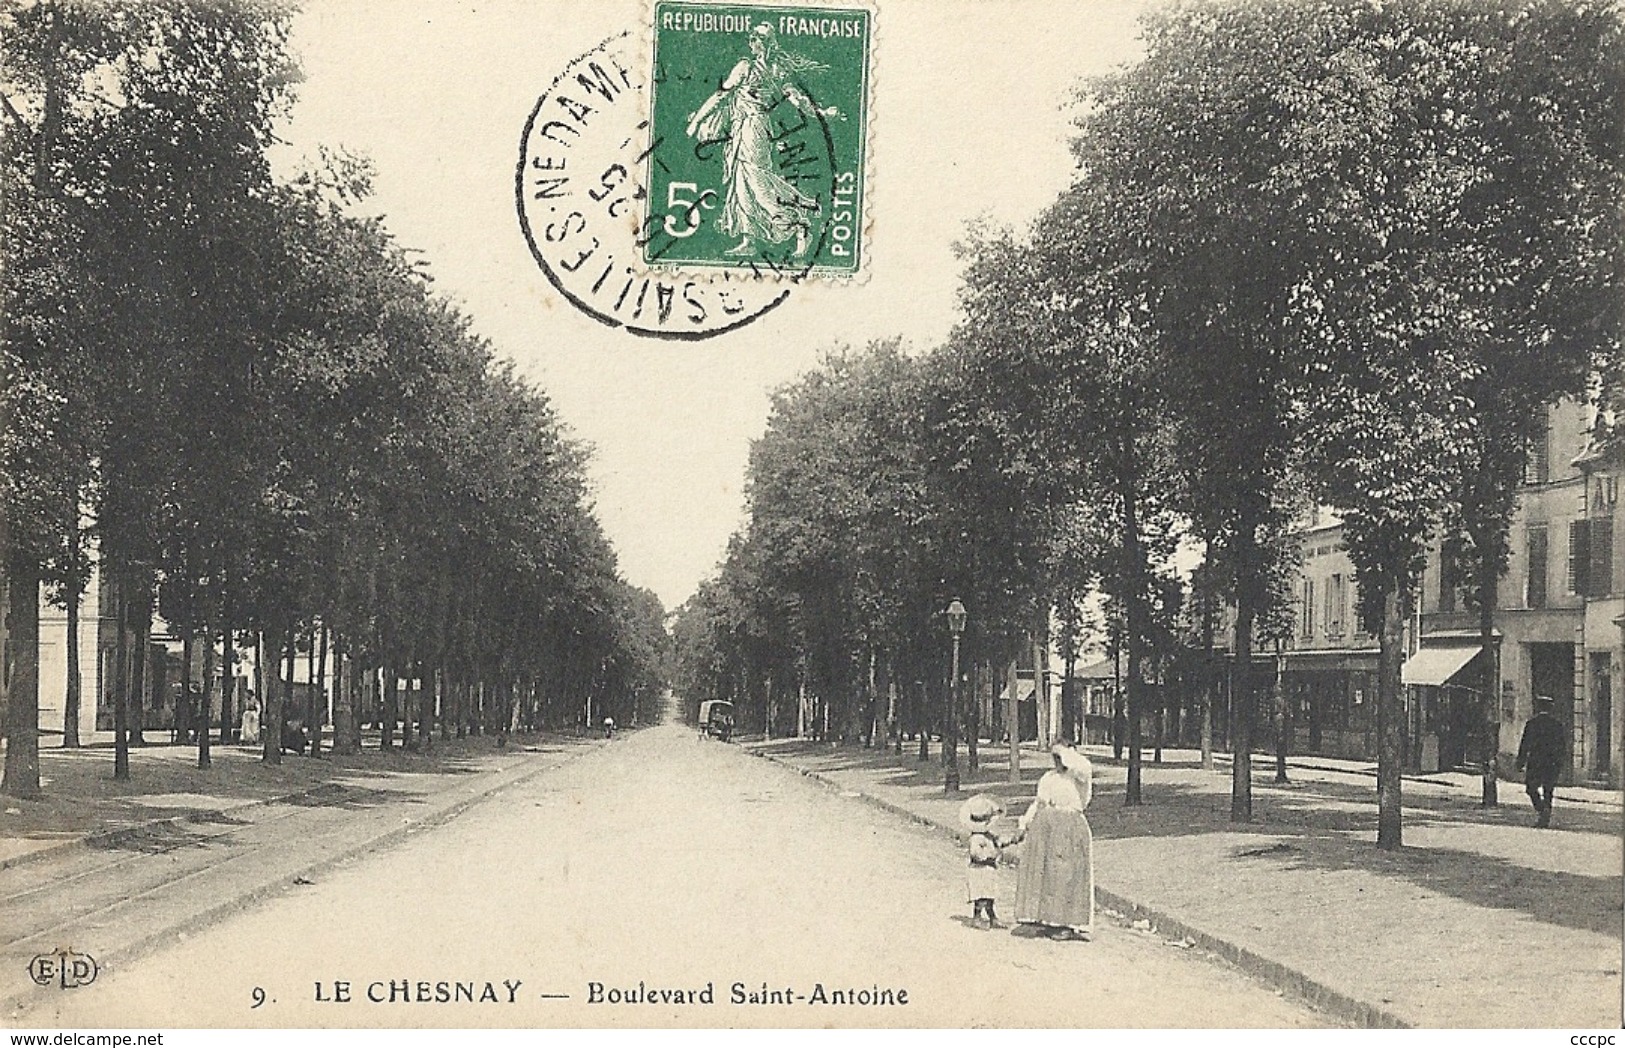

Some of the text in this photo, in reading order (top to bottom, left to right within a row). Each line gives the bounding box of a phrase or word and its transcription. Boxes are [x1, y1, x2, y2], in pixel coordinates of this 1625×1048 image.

[663, 11, 861, 38] REPUBLIQUE FRANÇAISE
[831, 171, 855, 257] POSTES
